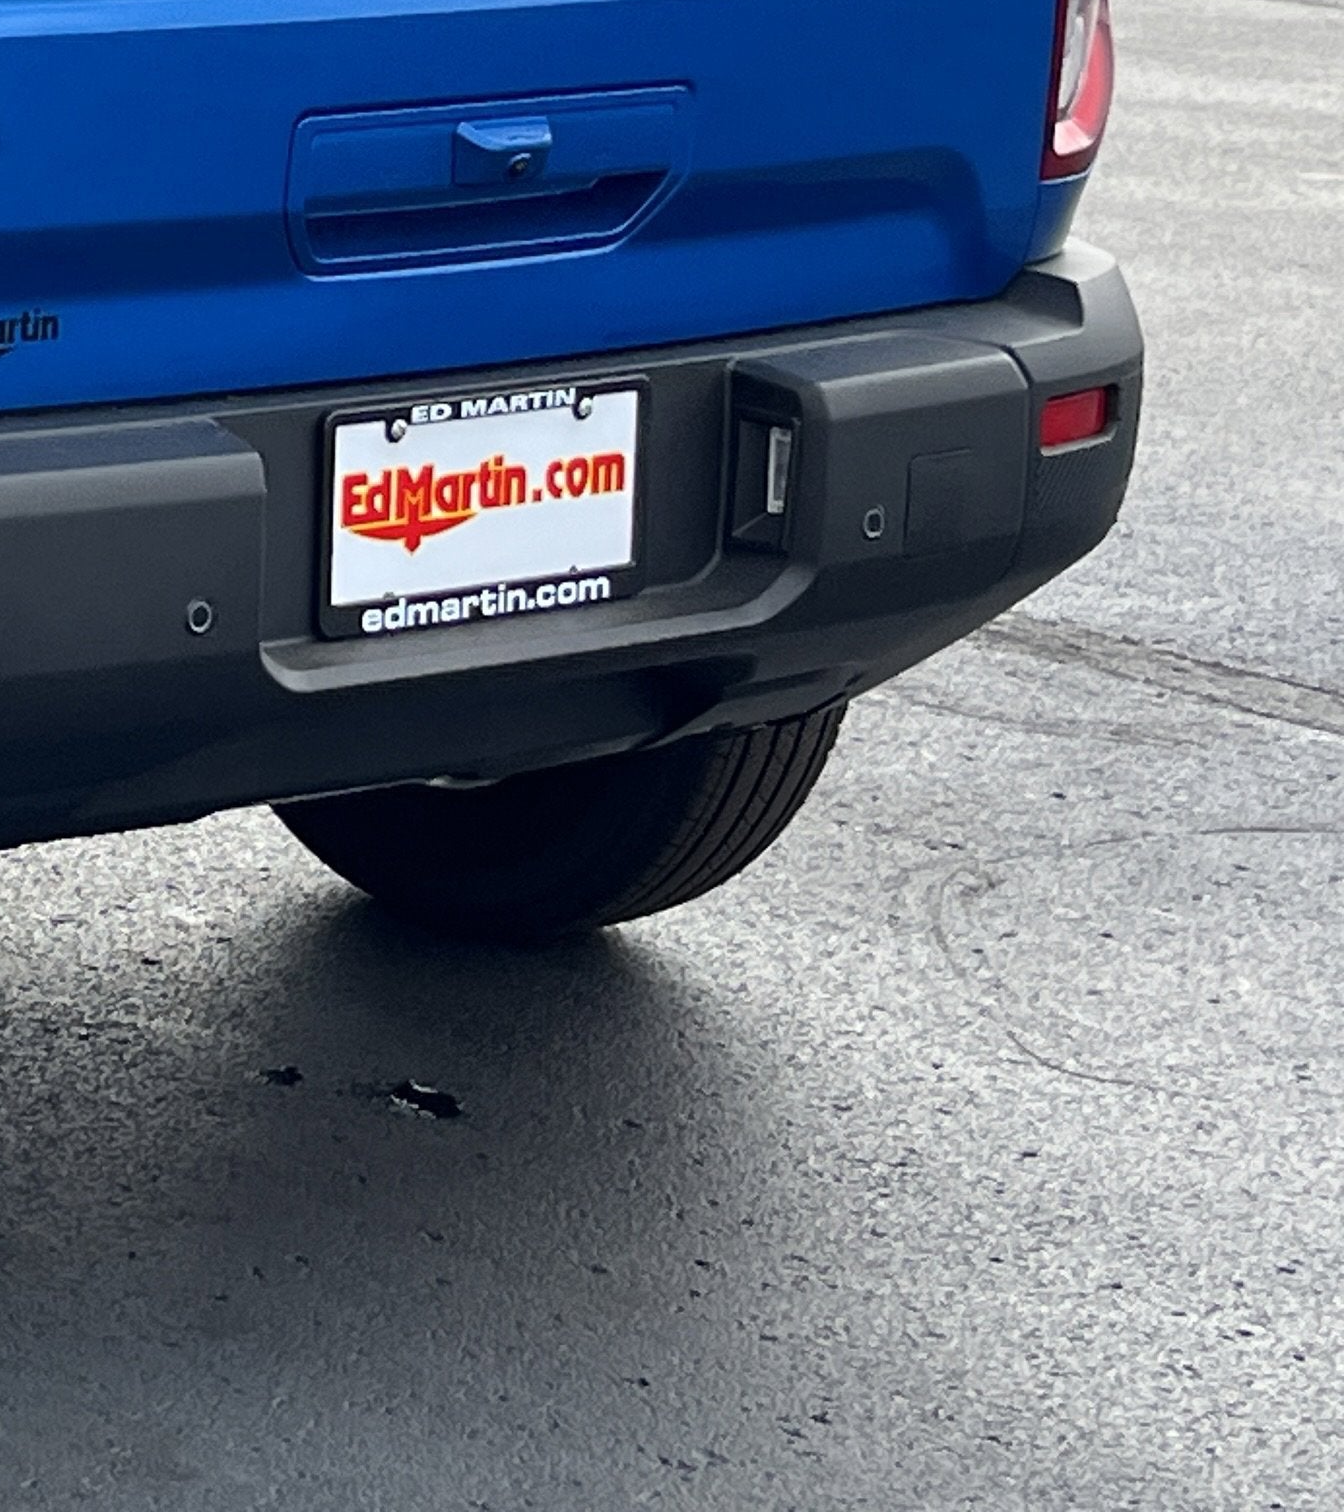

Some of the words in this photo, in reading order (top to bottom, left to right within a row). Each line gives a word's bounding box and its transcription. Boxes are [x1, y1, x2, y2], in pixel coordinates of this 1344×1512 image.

[411, 404, 452, 425] ED
[461, 388, 576, 419] MARTIN
[361, 576, 611, 633] edmartin.com
